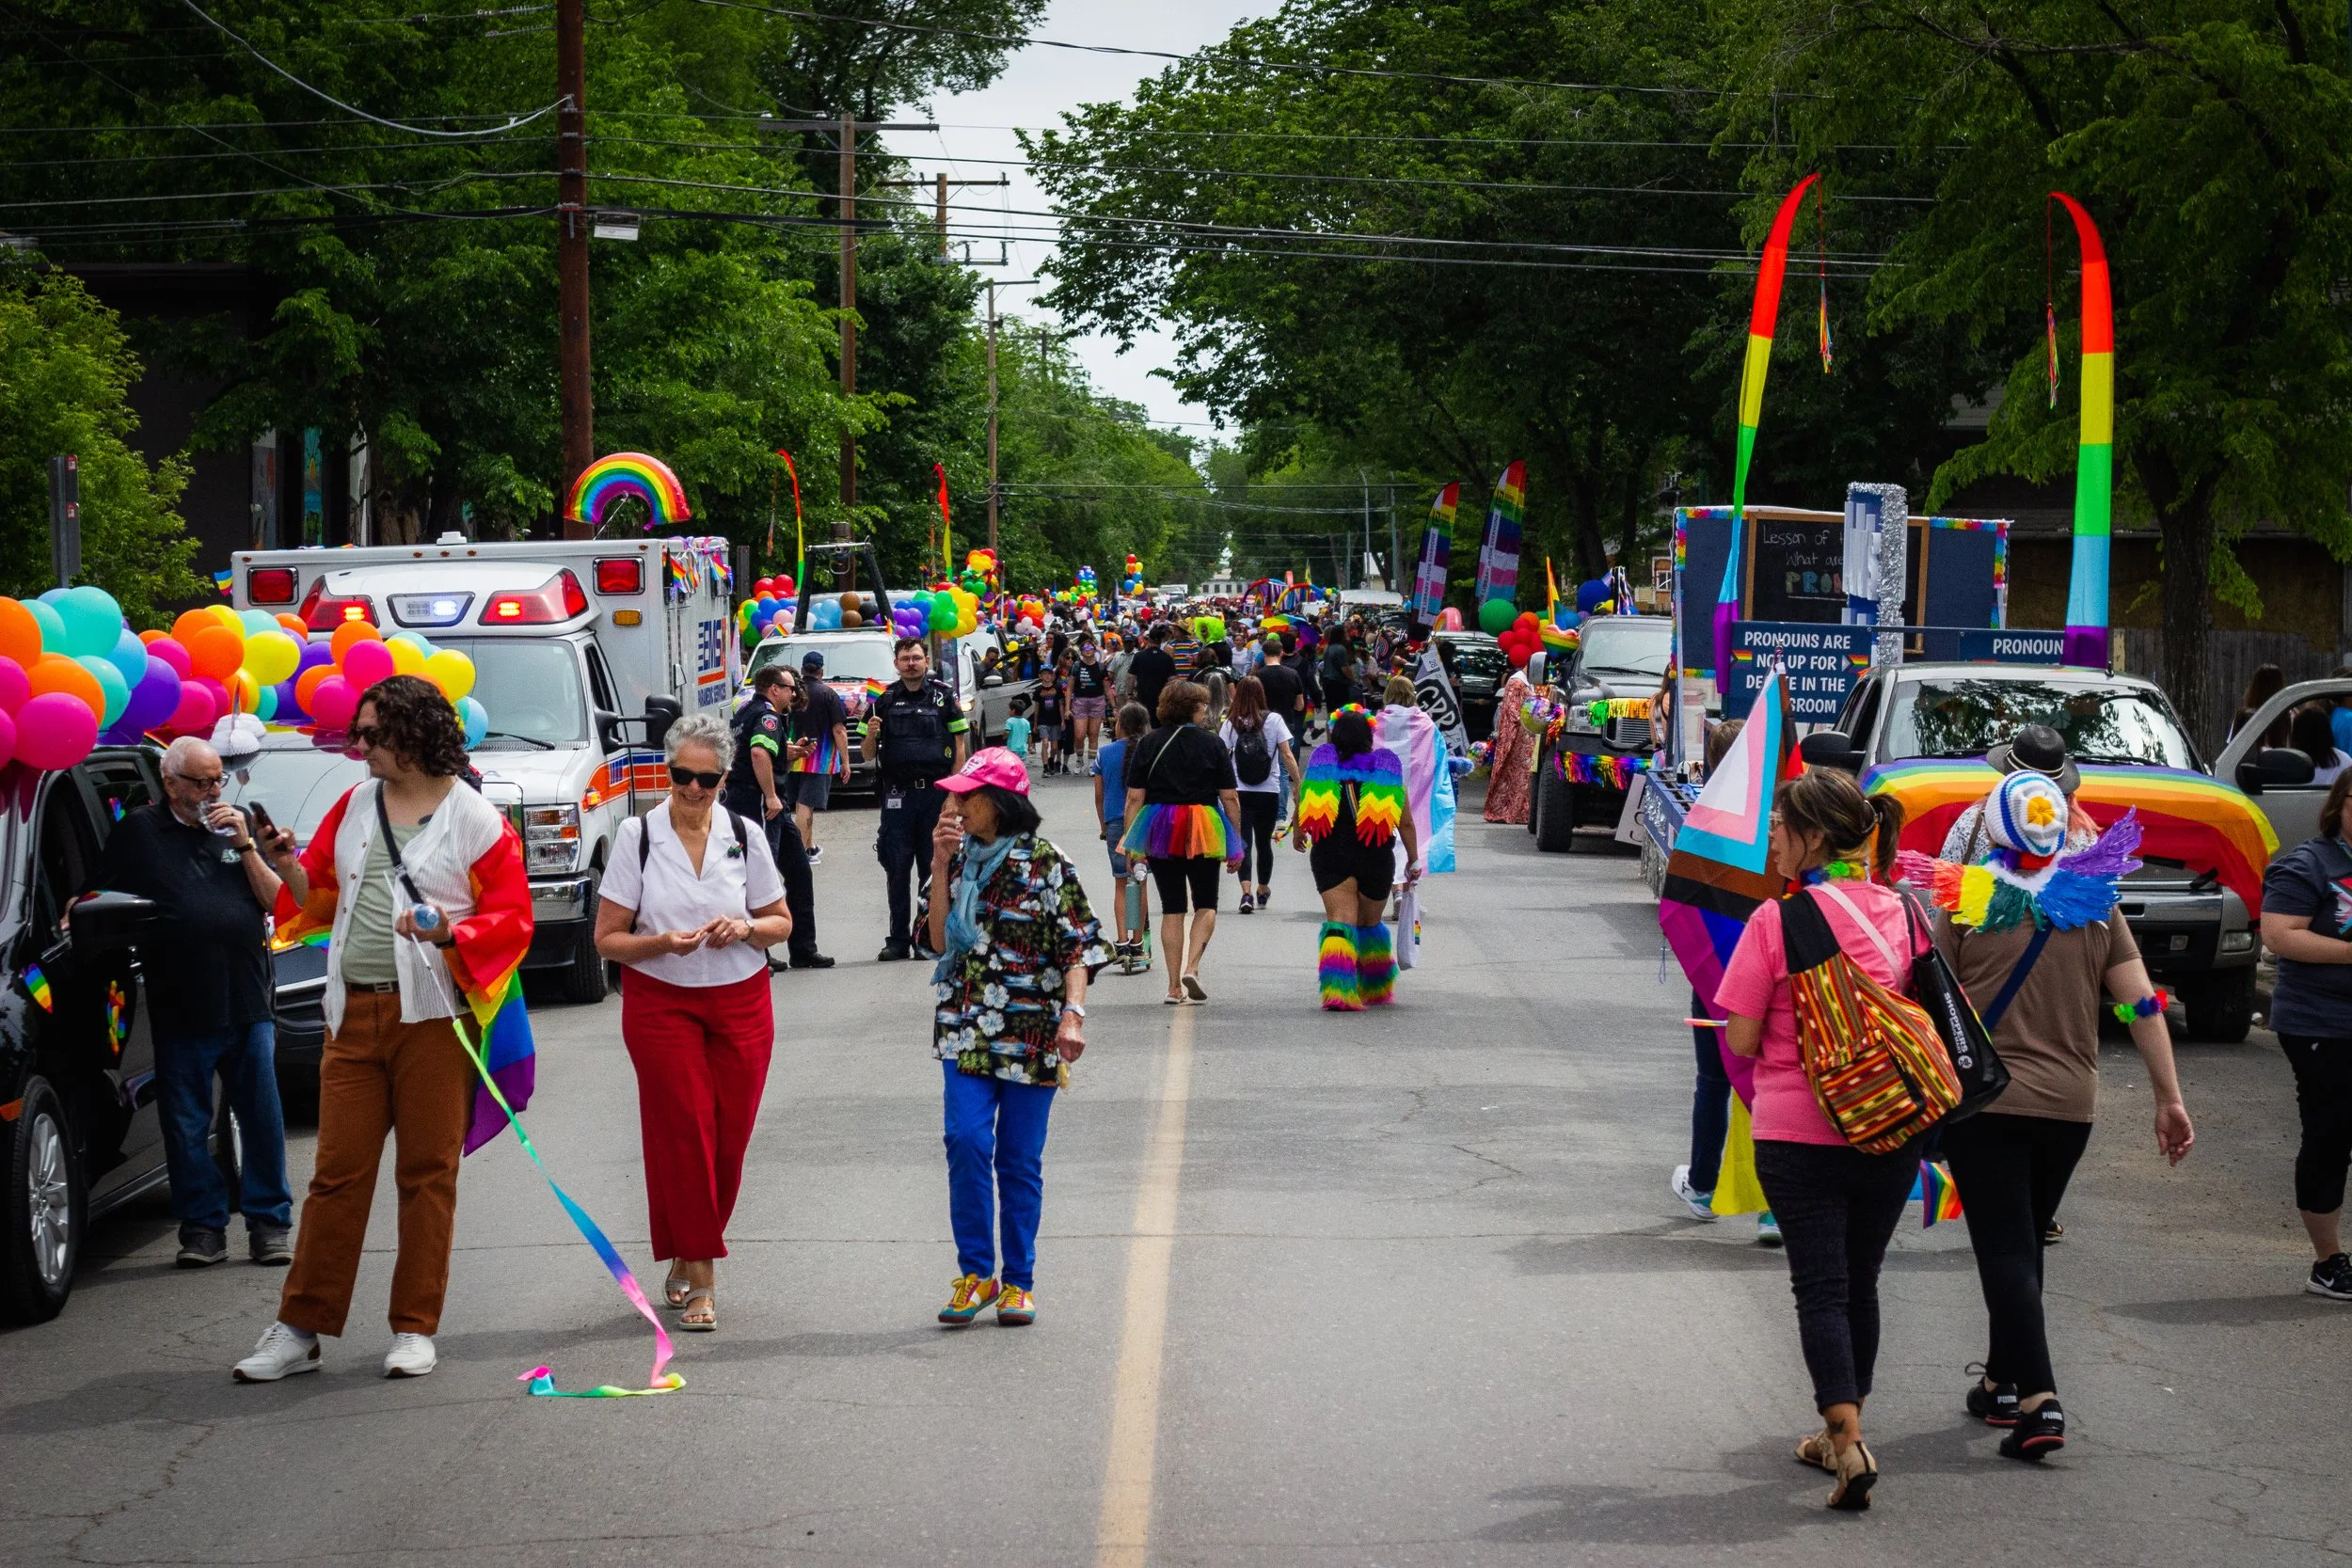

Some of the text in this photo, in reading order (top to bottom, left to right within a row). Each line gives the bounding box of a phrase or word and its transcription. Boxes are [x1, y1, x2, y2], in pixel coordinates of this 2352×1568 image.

[1763, 525, 1806, 546] Lesson
[1815, 530, 1831, 546] of
[1787, 551, 1844, 566] What are
[1786, 571, 1843, 594] PRON
[1744, 631, 1851, 649] PRONOUNS ARE
[1993, 639, 2064, 655] PRONOUN
[1788, 655, 1806, 669] UP
[1810, 656, 1836, 671] FOR
[1746, 674, 1846, 692] DEE IN THE
[1789, 697, 1836, 714] SROOM
[1944, 991, 1968, 1053] SHOPPERS
[1949, 1019, 1963, 1053] DRUG MART
